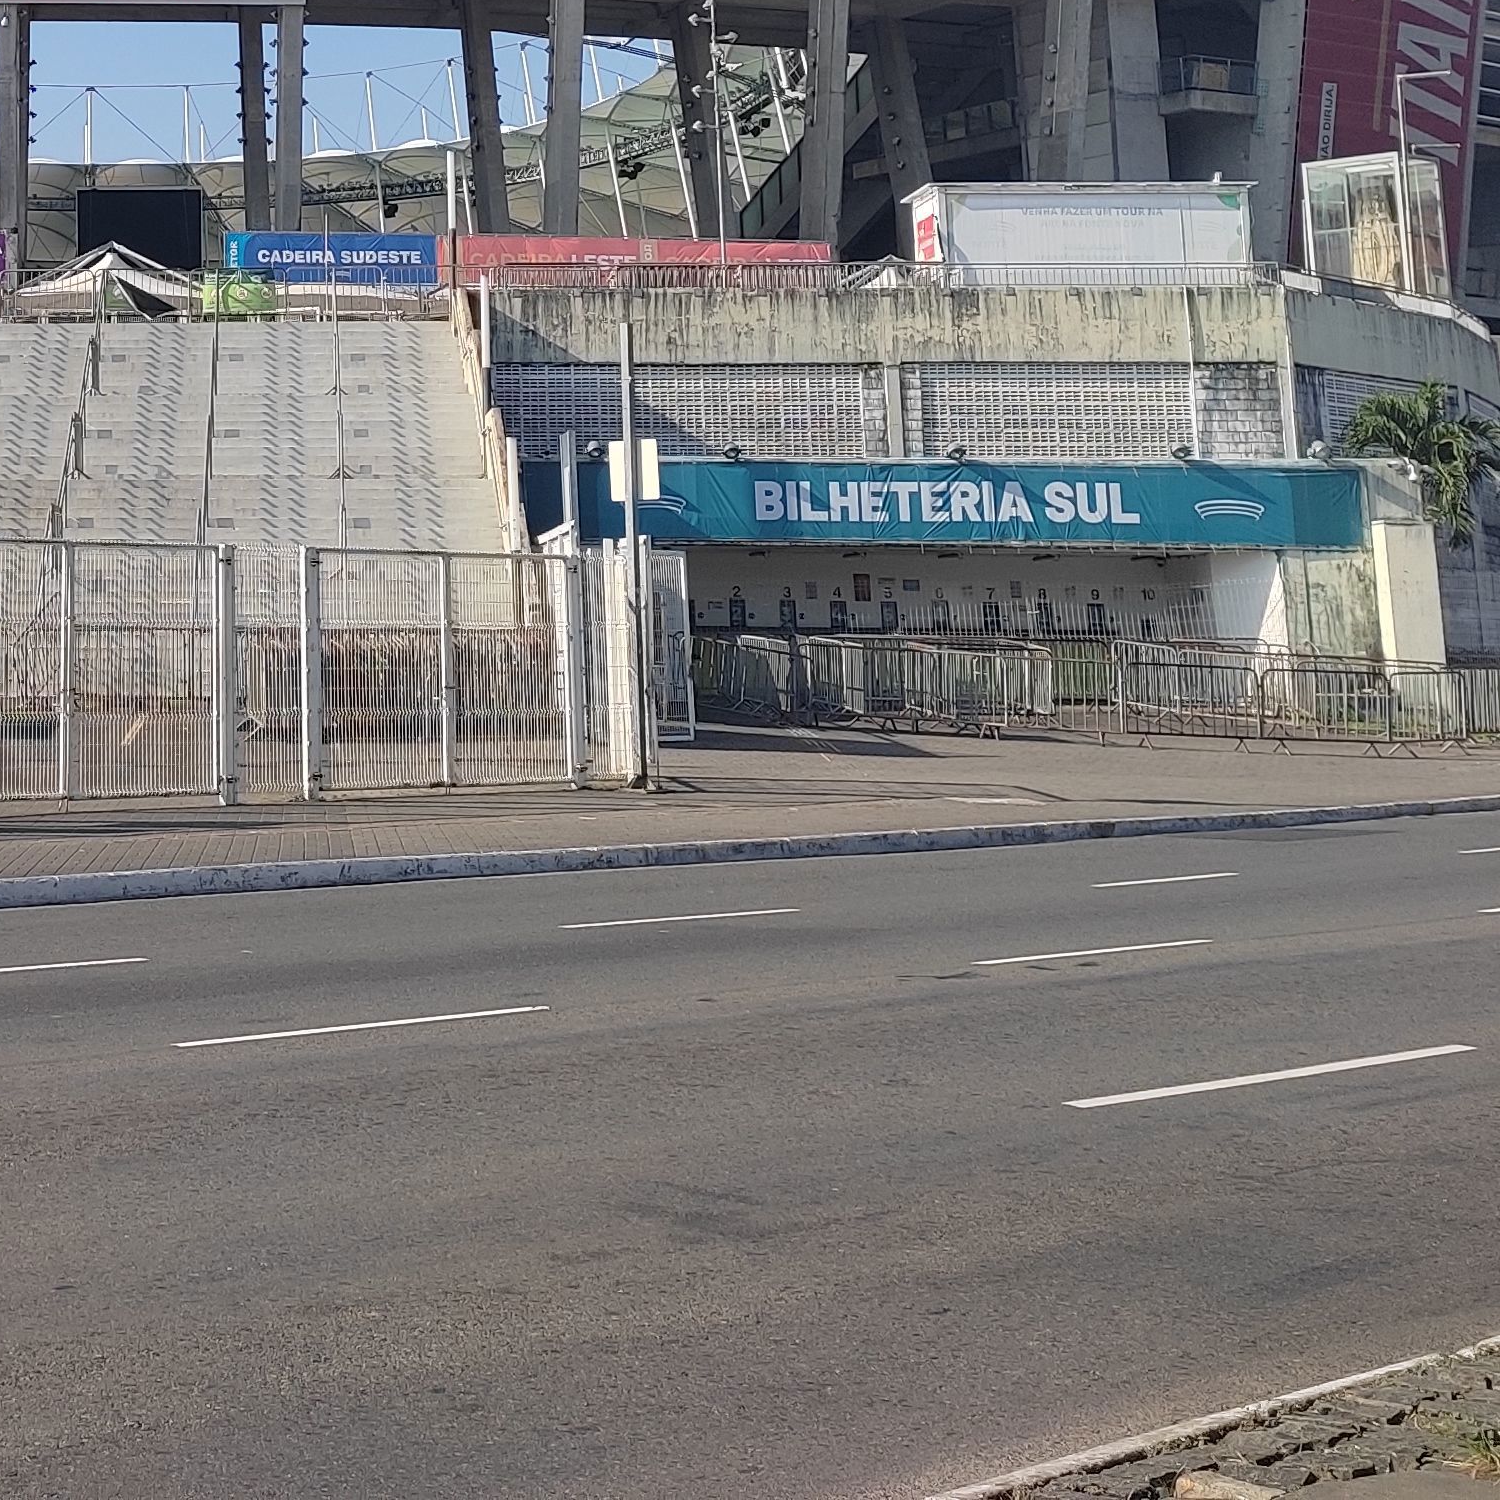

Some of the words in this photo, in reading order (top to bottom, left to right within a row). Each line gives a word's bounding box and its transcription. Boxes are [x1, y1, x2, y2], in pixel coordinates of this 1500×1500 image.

[1323, 85, 1335, 131] DIRIJA.
[1319, 135, 1330, 159] ÃO
[229, 240, 238, 267] ETOR
[257, 249, 335, 264] CADEIRA
[341, 250, 422, 265] SUDESTE
[753, 480, 1034, 523] BILHETERIA
[1043, 481, 1141, 525] SUL
[732, 586, 741, 597] 2
[783, 587, 791, 598] 3
[832, 587, 841, 598] 4
[884, 588, 893, 599] 5
[986, 588, 996, 600] 7
[1037, 588, 1047, 600] 8
[1091, 589, 1100, 600] 9
[1141, 588, 1156, 600] 10
